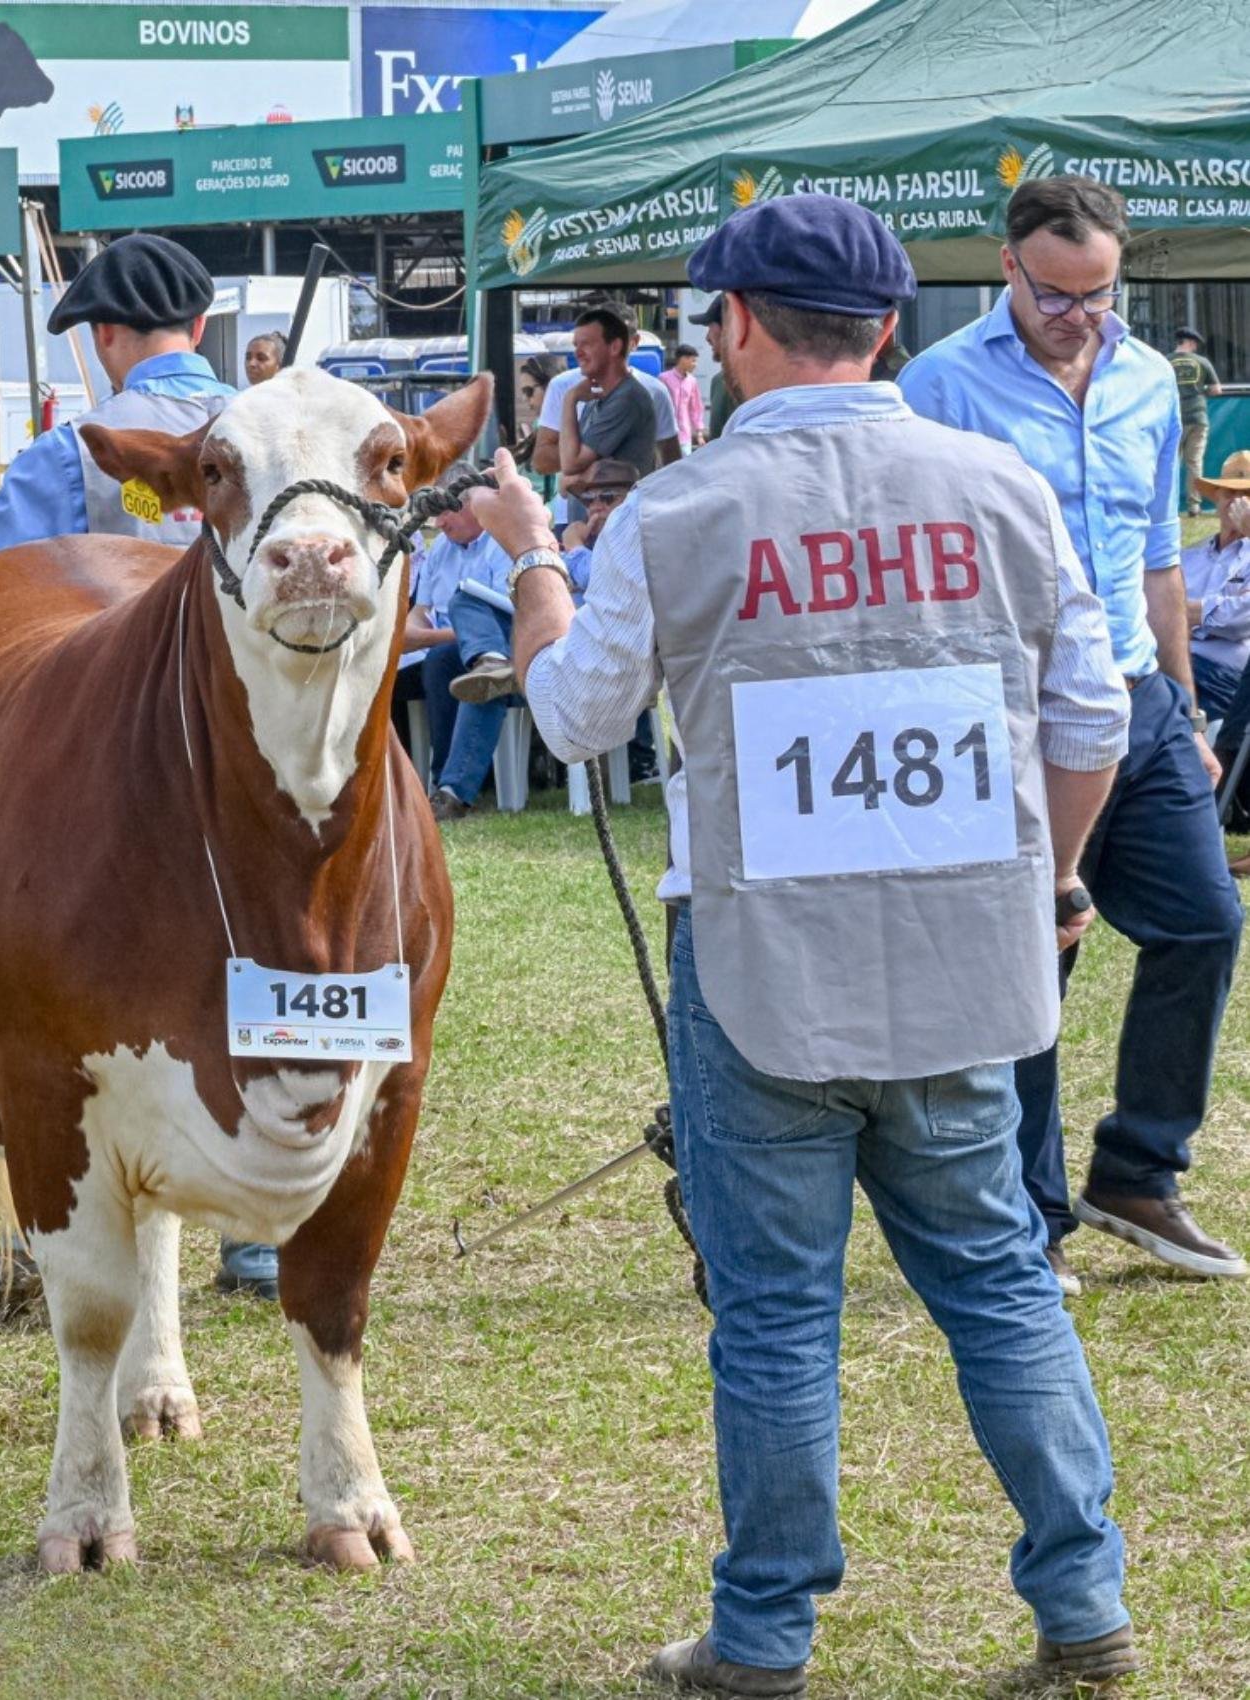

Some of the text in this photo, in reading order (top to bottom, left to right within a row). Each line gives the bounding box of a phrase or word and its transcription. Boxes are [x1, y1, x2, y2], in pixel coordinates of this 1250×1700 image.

[139, 20, 250, 45] BOVINOS
[617, 78, 653, 106] SENAR
[211, 156, 273, 172] PARCEIRO DE
[342, 155, 398, 176] SICOOB
[429, 163, 463, 179] GERAÇ
[1063, 157, 1175, 187] SISTEMA
[114, 169, 166, 190] SICOOB
[245, 175, 261, 189] DO
[262, 174, 290, 188] AGRO
[792, 169, 985, 203] SISTEMA FARSUL
[636, 186, 719, 223] FARSUL
[1125, 198, 1178, 217] SENAR
[1185, 198, 1226, 217] CASA
[900, 211, 937, 231] CASA
[937, 208, 987, 229] RURAL
[593, 234, 642, 256] SENAR
[646, 229, 681, 250] CASA
[736, 521, 981, 621] ABHB
[775, 721, 992, 816] 1481
[269, 982, 367, 1020] 1481
